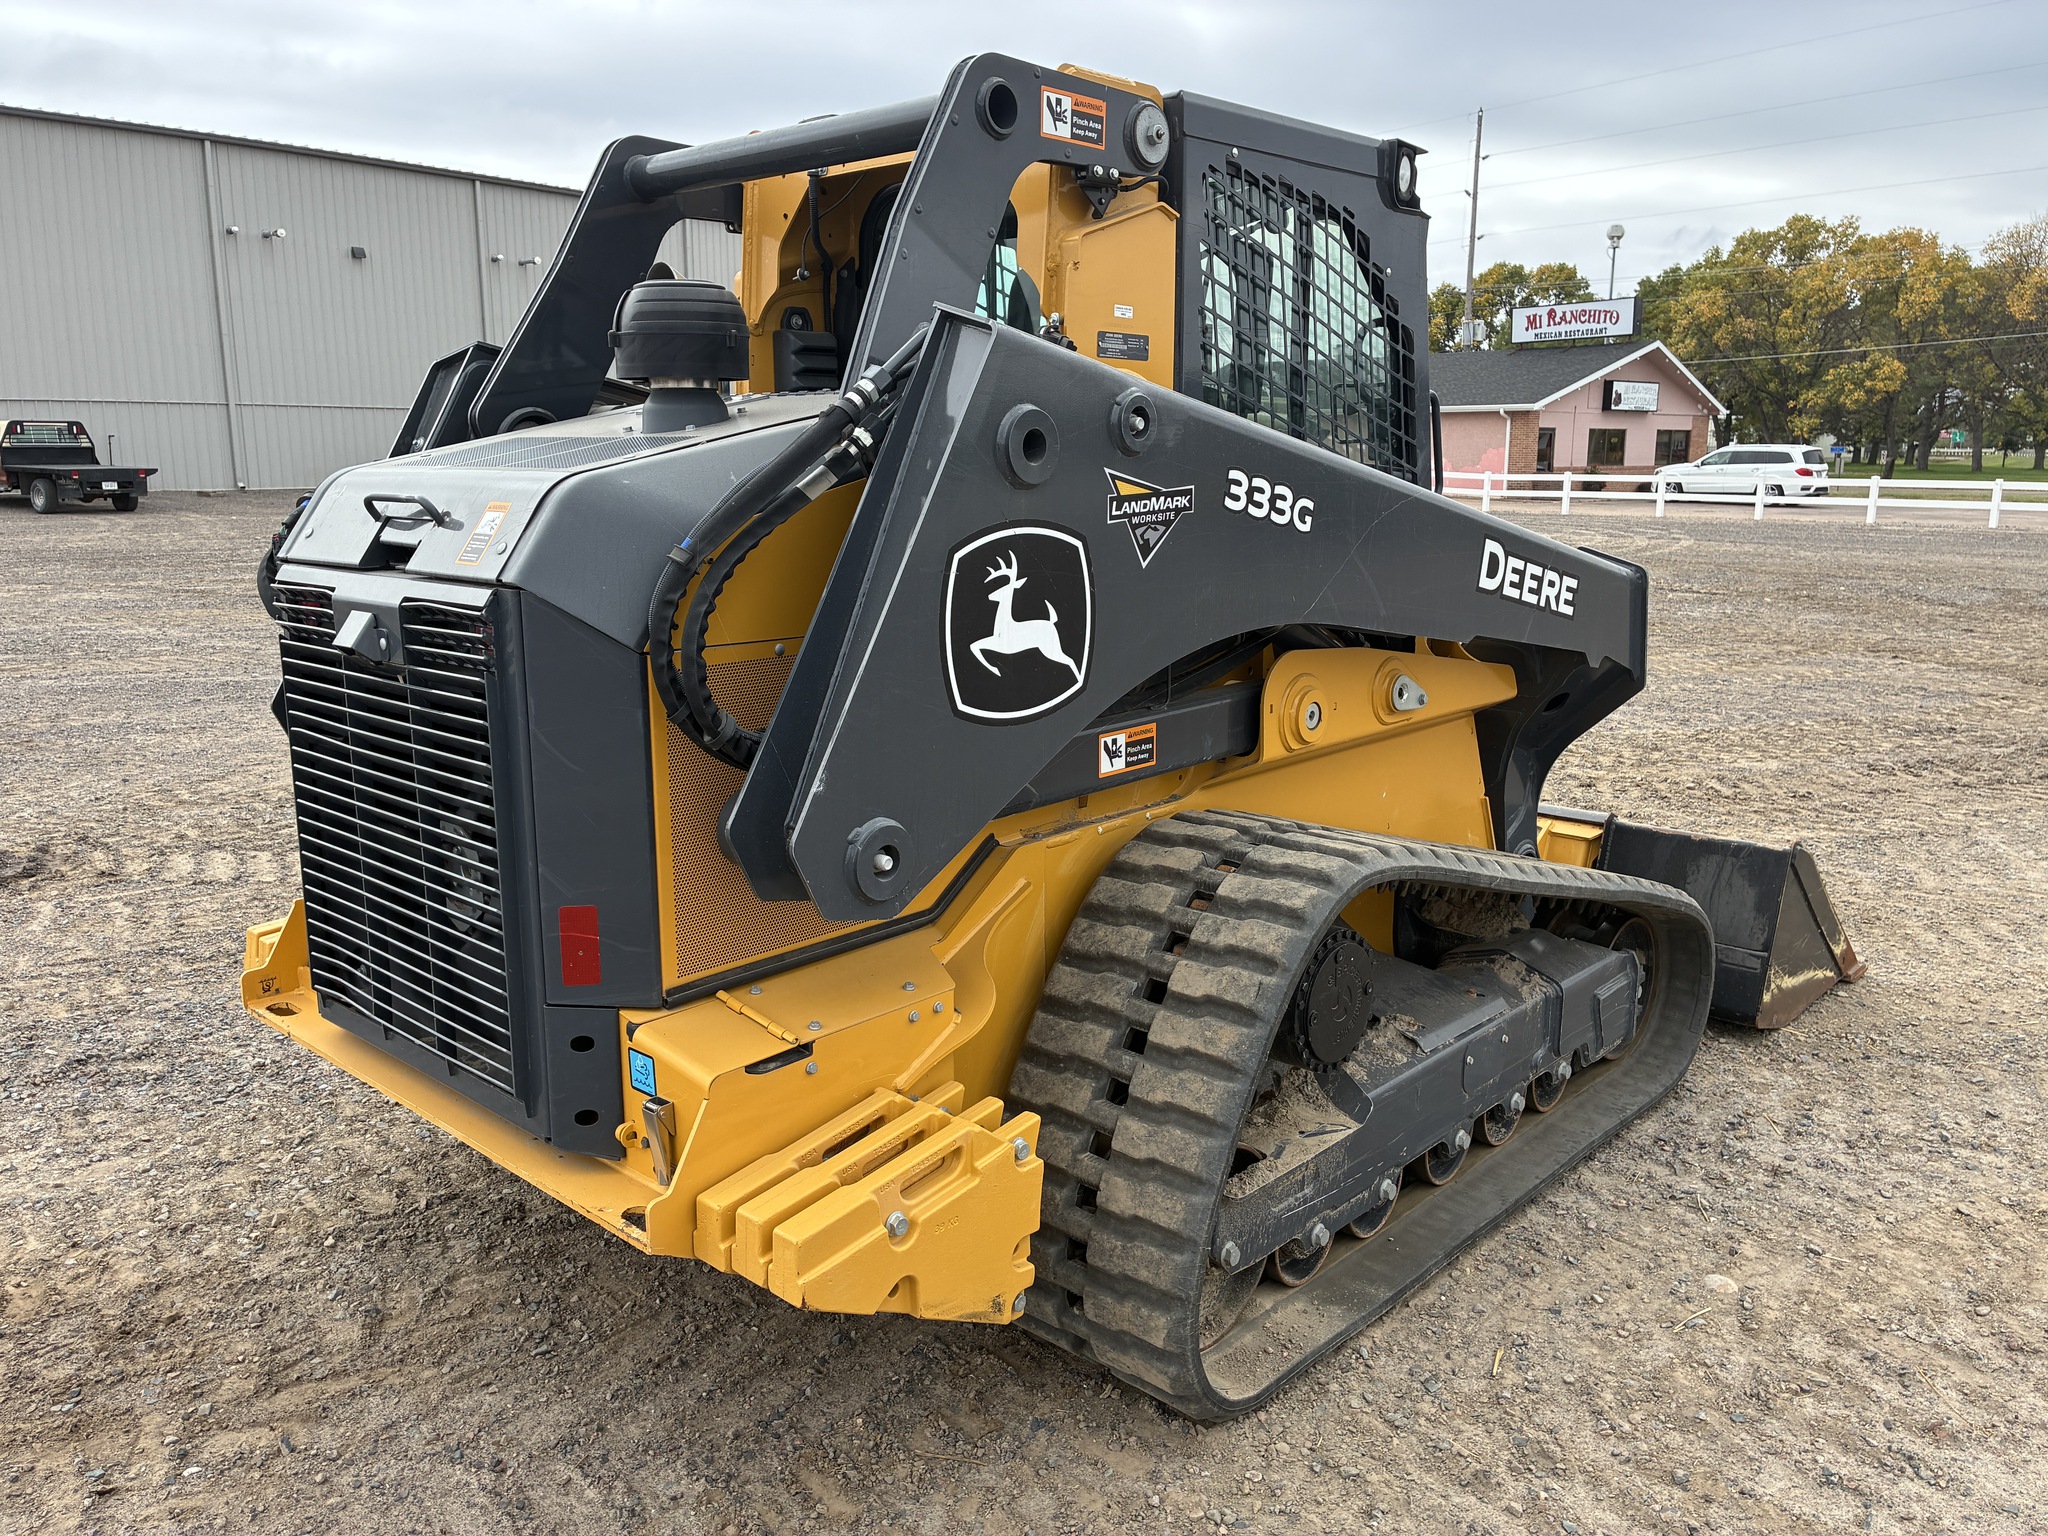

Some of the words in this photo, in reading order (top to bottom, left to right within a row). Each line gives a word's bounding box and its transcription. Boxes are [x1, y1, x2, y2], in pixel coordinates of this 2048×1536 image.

[1079, 101, 1102, 112] WARNING
[1073, 116, 1088, 127] Pinch
[1089, 120, 1101, 129] Area
[1073, 127, 1084, 136] Keep
[1085, 130, 1097, 139] Away
[1525, 313, 1543, 332] MI
[1546, 307, 1620, 328] RANCHITO
[1534, 331, 1563, 341] MEXICAN
[1564, 327, 1608, 339] RESTAURANT
[1111, 496, 1190, 515] LANDMARK
[1224, 469, 1314, 532] 333G
[1132, 512, 1175, 524] WORKSITE
[1478, 538, 1579, 617] DEERE
[1132, 728, 1153, 737] WARNING
[1127, 745, 1140, 754] Pinch
[801, 1148, 817, 1162] USA
[842, 1162, 858, 1176] USA
[880, 1180, 895, 1194] USA
